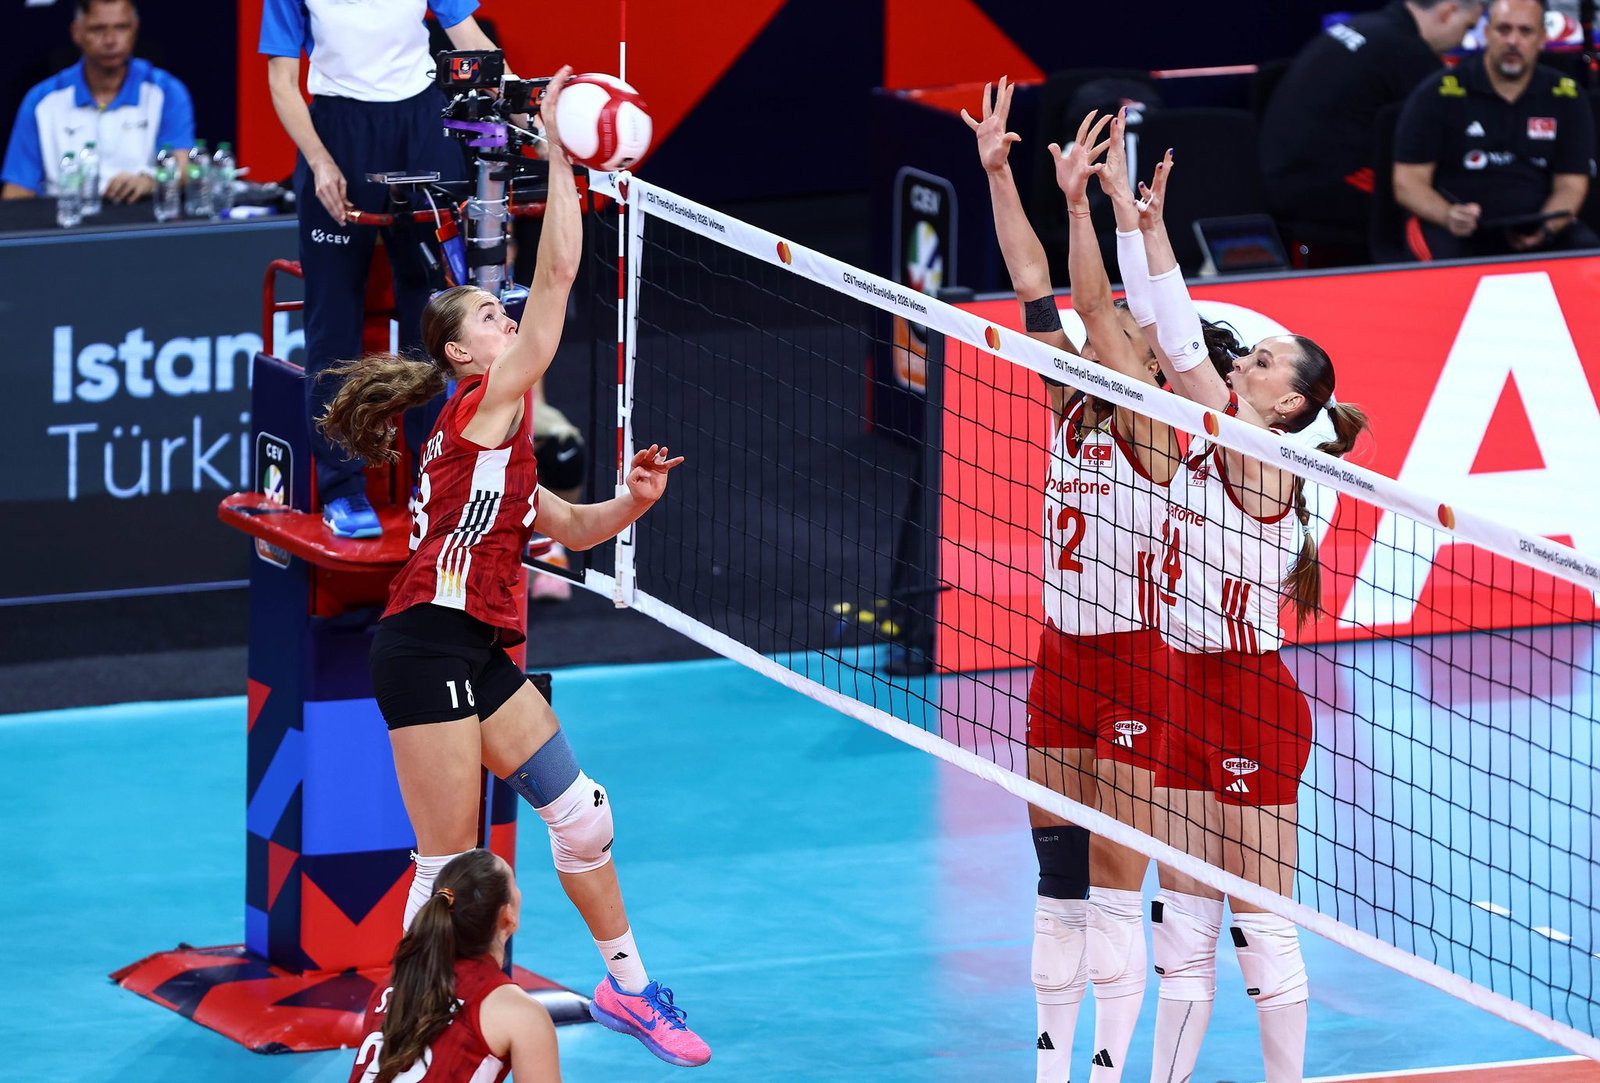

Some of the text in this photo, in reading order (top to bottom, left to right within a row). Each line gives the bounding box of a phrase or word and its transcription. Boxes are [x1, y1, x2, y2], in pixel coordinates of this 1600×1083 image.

[326, 233, 350, 245] CEV
[53, 312, 398, 402] Istan
[1053, 358, 1144, 402] CEV Trendyol EuroVolley 2026 Women
[48, 412, 250, 500] Türki
[266, 443, 283, 461] CEV
[446, 679, 475, 709] 18
[1225, 760, 1256, 770] gratis
